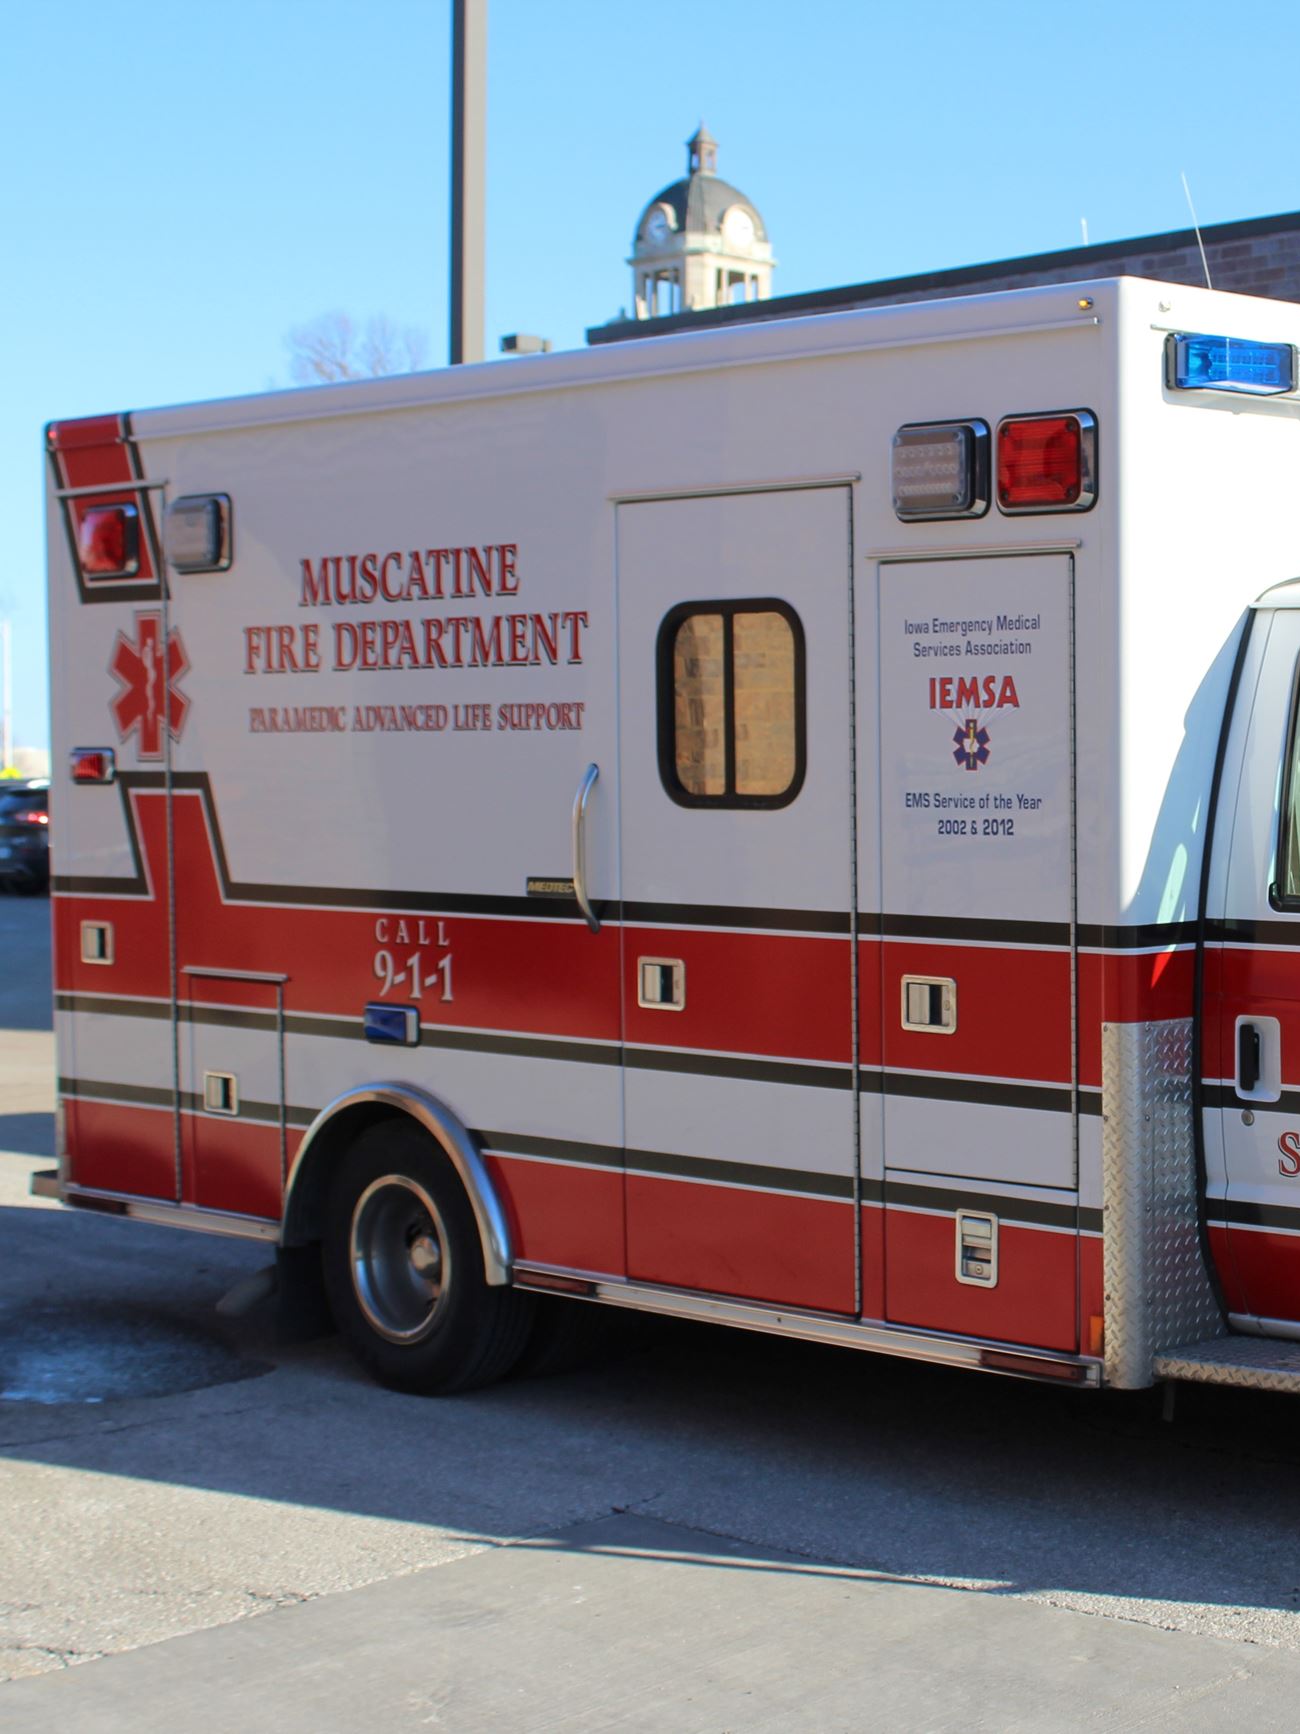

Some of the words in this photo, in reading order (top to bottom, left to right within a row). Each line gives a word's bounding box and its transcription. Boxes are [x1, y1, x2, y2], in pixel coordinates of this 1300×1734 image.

[299, 543, 520, 606] MUSCATINE
[904, 619, 929, 635] Iowa
[932, 617, 993, 637] Emergency
[996, 614, 1041, 631] Medical
[243, 623, 320, 674] FIRE
[333, 611, 588, 671] DEPARTMENT
[913, 642, 961, 657] Services
[965, 639, 1032, 656] Association
[929, 675, 1020, 709] IEMSA
[249, 706, 346, 733] PARAMEDIC
[352, 704, 448, 732] ADVANCED
[453, 703, 492, 731] LIFE
[500, 702, 585, 731] SUPPORT
[905, 793, 930, 808] EMS
[933, 793, 975, 809] Service
[978, 794, 990, 809] of
[993, 794, 1012, 809] the
[1016, 793, 1042, 809] Year
[938, 820, 967, 835] 2002
[970, 820, 978, 835] &
[982, 819, 1014, 836] 2012
[375, 918, 450, 946] CALL
[373, 949, 454, 1002] 9-1-1
